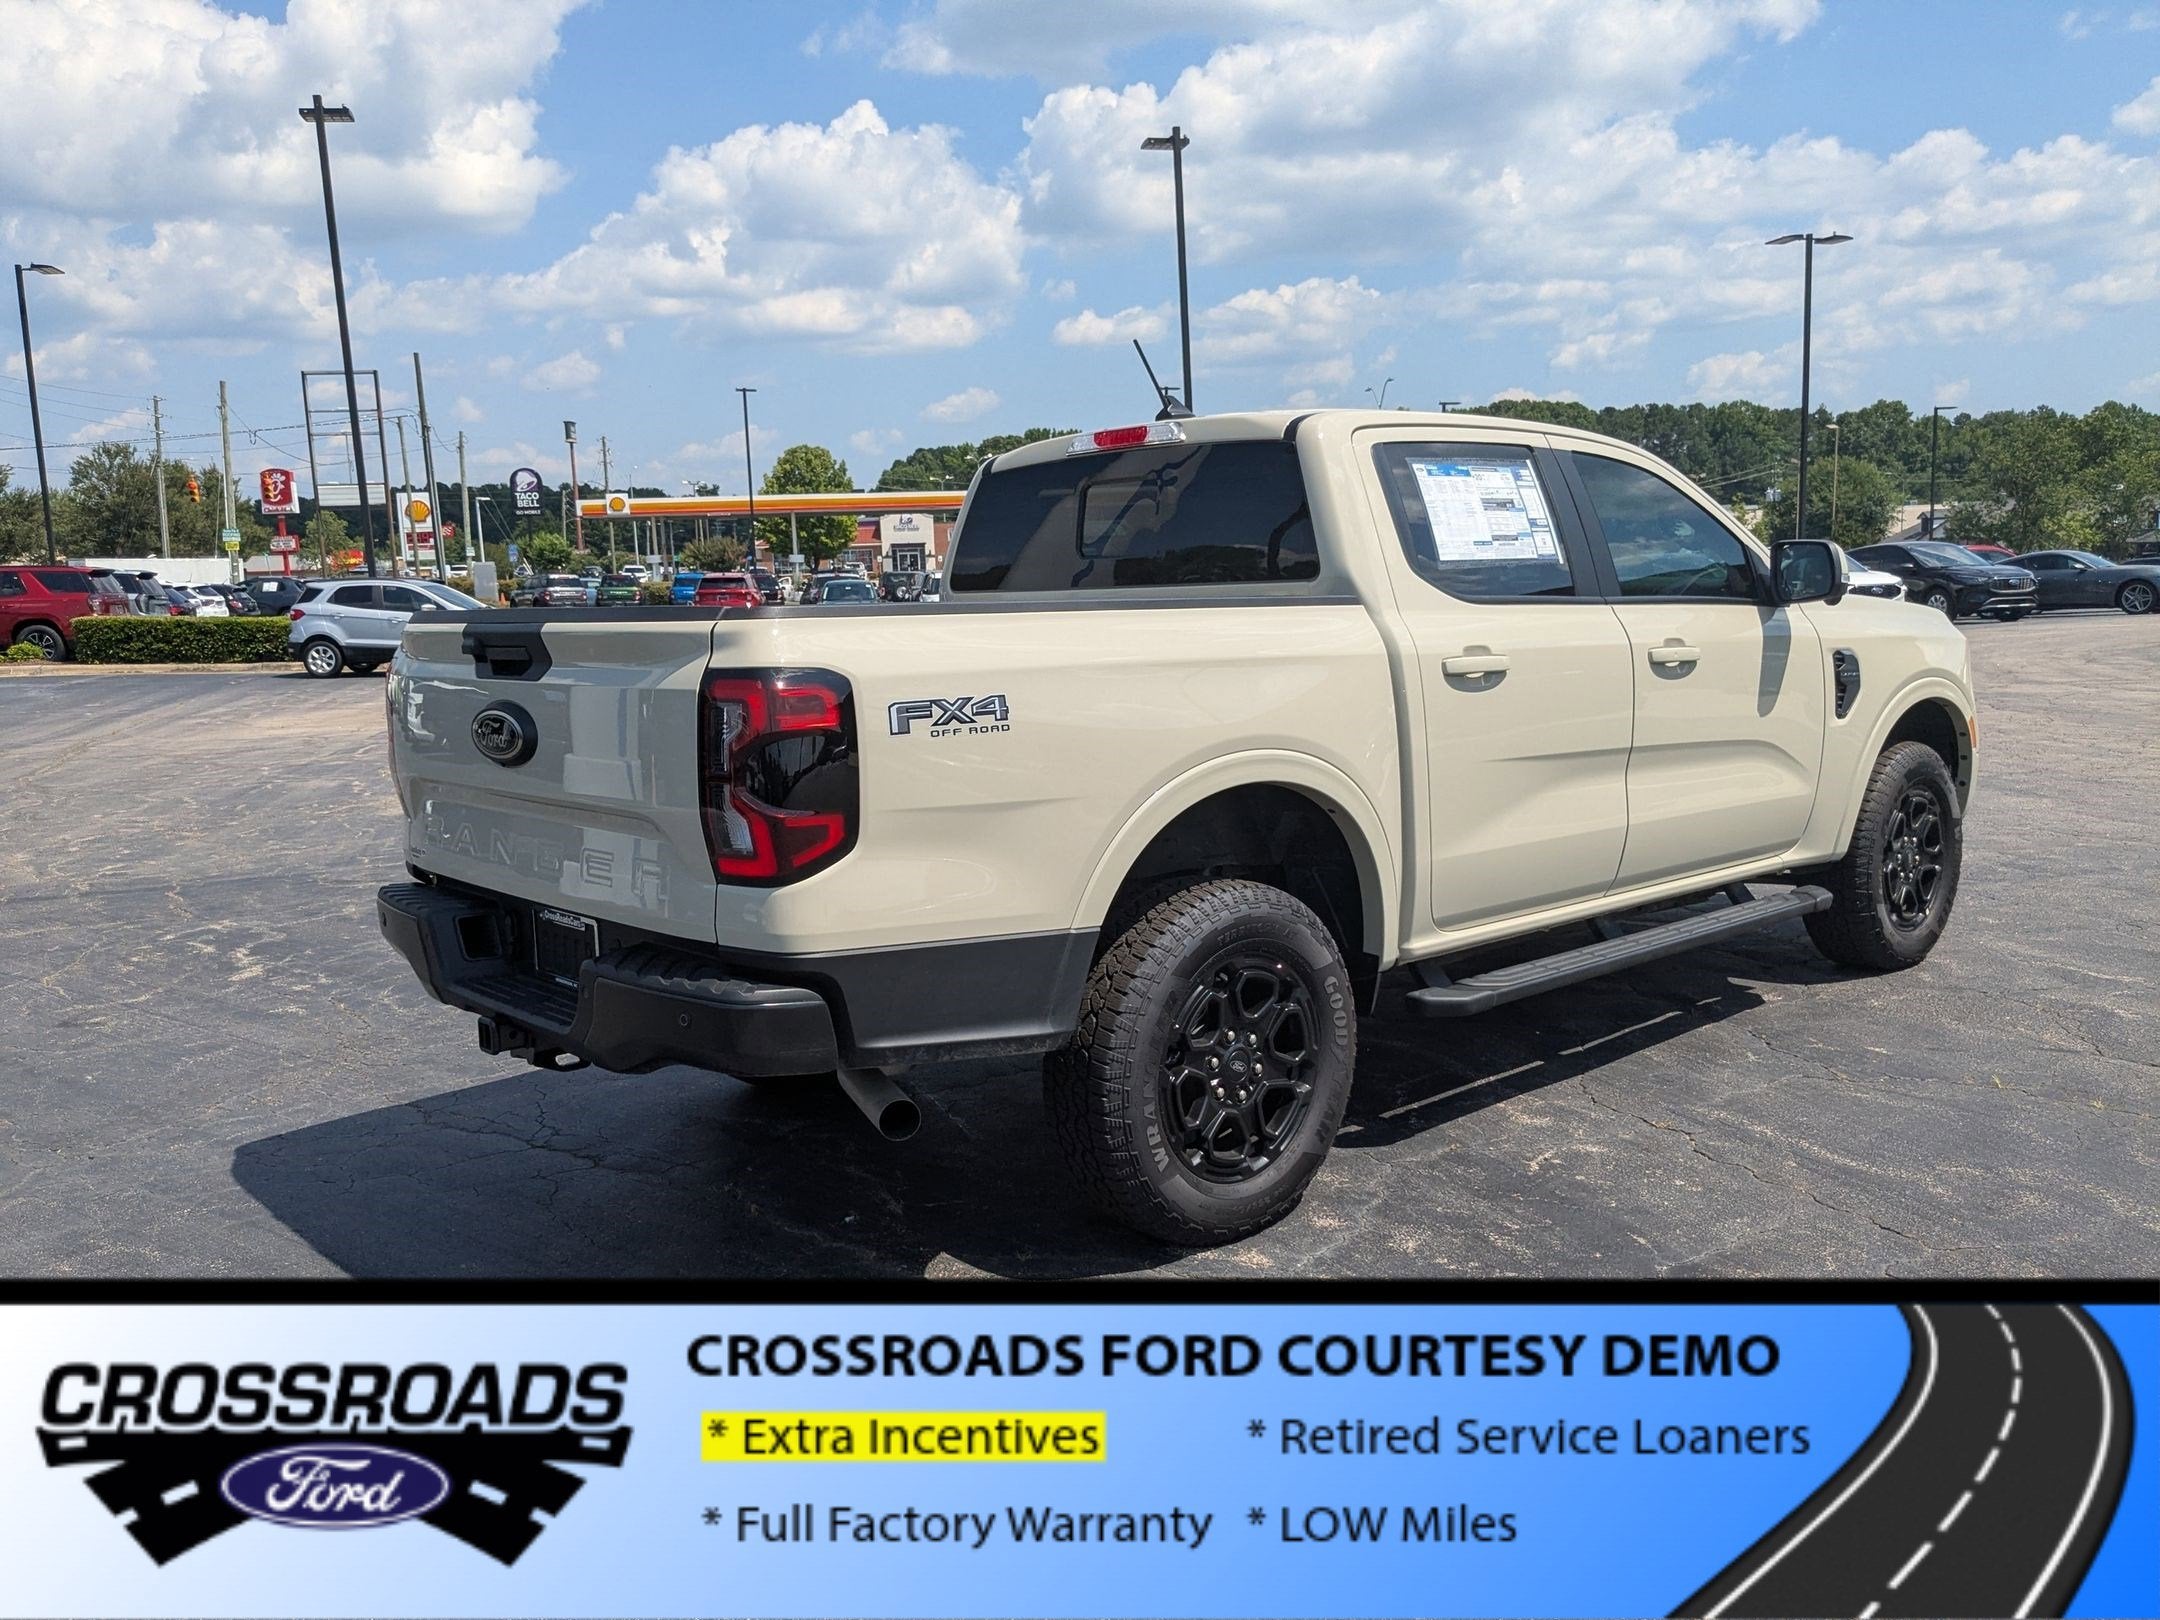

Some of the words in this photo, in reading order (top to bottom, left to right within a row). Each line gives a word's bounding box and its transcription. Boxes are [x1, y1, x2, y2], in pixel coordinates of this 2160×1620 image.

[514, 492, 540, 500] TACO
[888, 694, 1009, 735] FX4
[930, 728, 962, 737] OFF
[969, 724, 1010, 734] ROAD
[424, 812, 672, 919] RANGER
